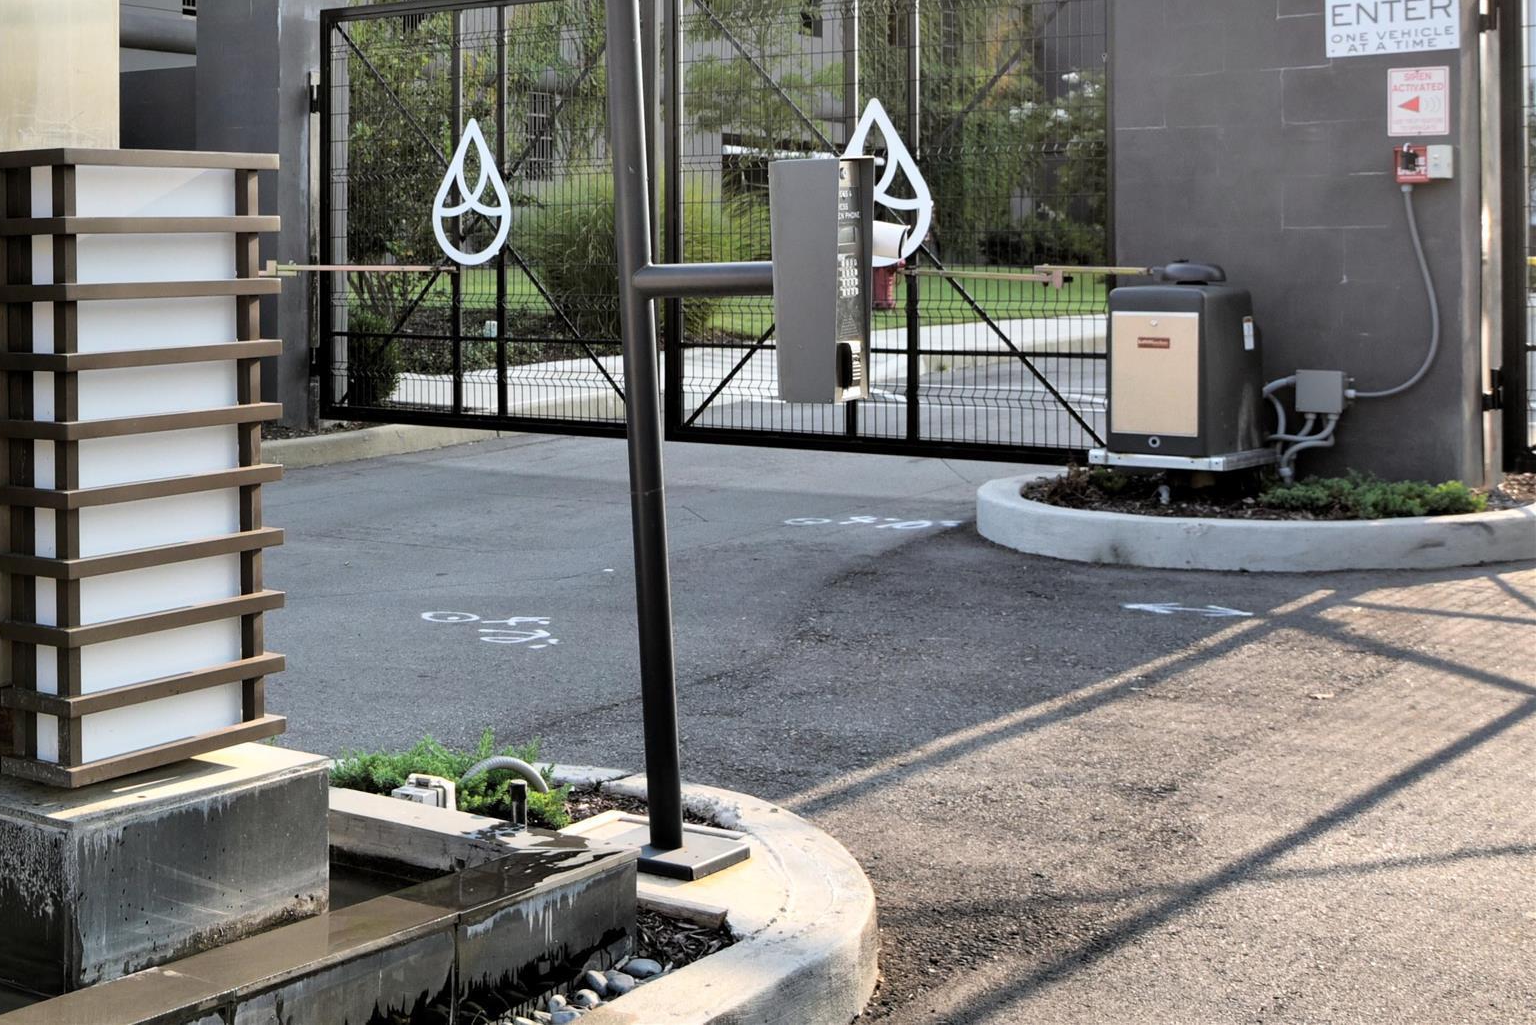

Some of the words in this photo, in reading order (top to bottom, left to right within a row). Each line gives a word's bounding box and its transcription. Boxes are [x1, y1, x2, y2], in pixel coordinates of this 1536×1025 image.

[1331, 32, 1369, 44] ONE
[1376, 25, 1455, 41] VEHICLE
[1347, 42, 1369, 54] AT
[1376, 41, 1386, 51] A
[1394, 37, 1438, 50] TIME
